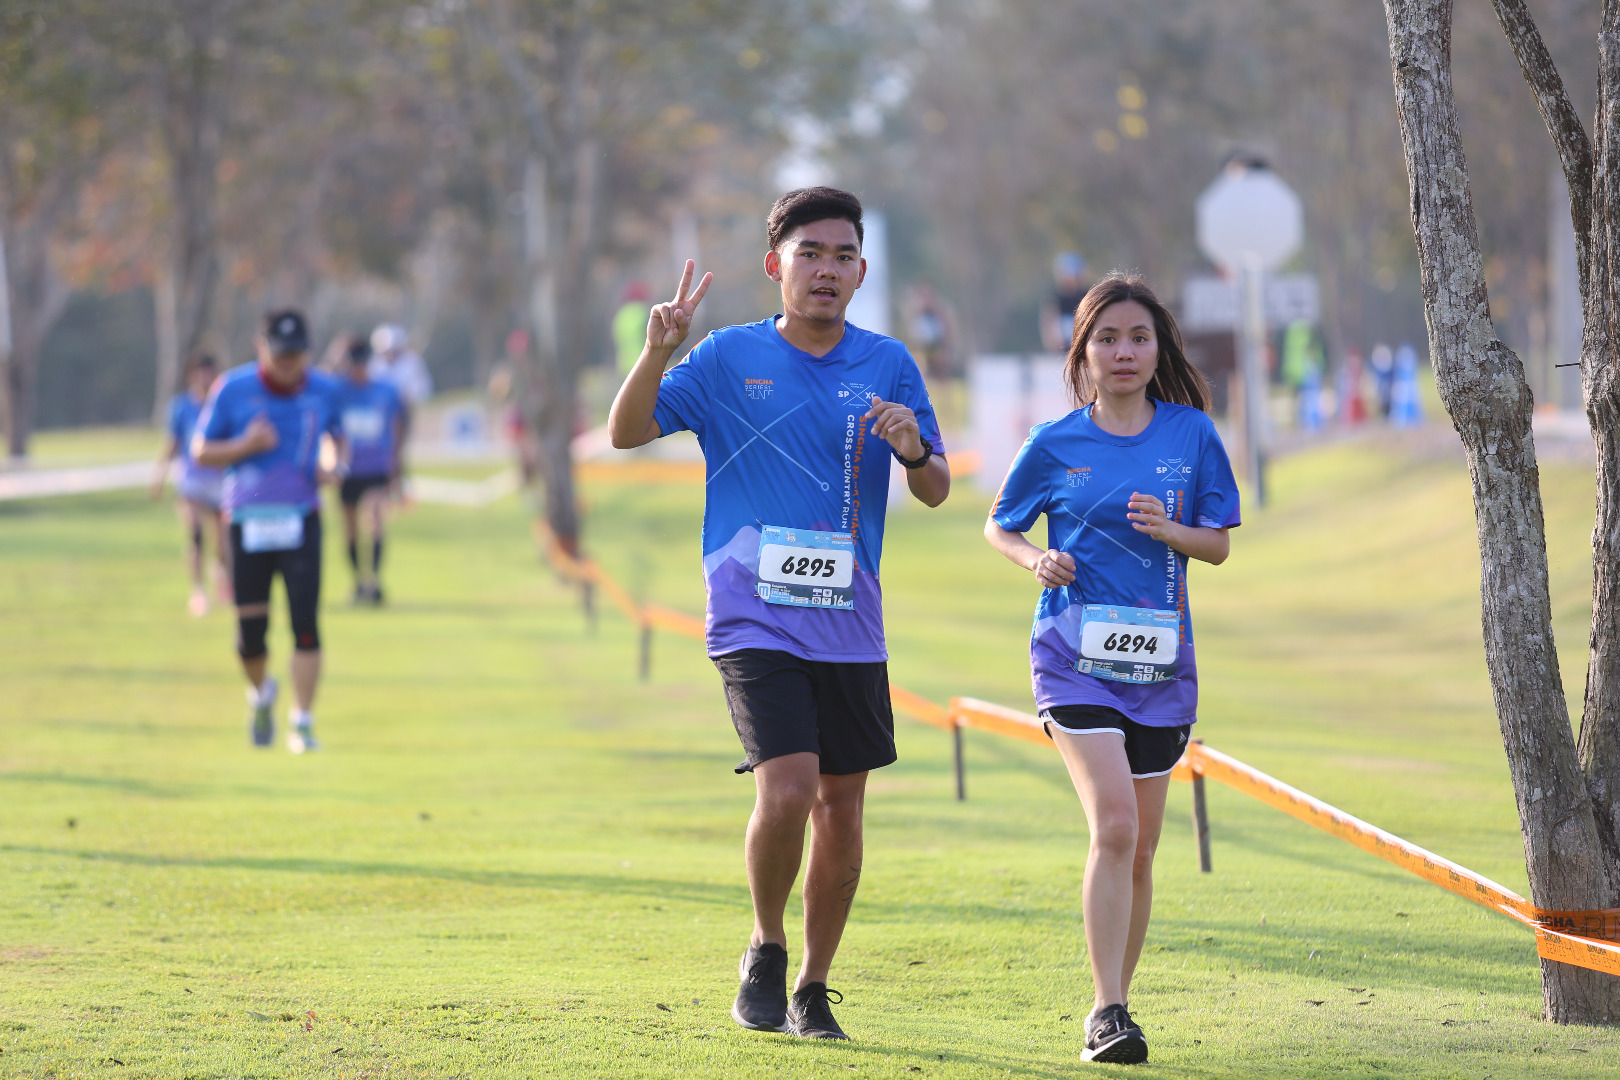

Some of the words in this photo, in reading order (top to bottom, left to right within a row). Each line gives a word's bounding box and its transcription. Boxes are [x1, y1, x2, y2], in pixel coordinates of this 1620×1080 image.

[838, 390, 850, 398] SP
[845, 414, 855, 450] CROSS
[854, 416, 867, 463] SINGHA
[844, 453, 852, 505] COUNTRY
[1156, 466, 1168, 474] SP
[1175, 490, 1184, 523] SING
[842, 507, 850, 529] RUN
[781, 556, 836, 577] 6295
[833, 594, 844, 607] 16
[1166, 582, 1175, 604] RUN
[1103, 632, 1158, 655] 6294
